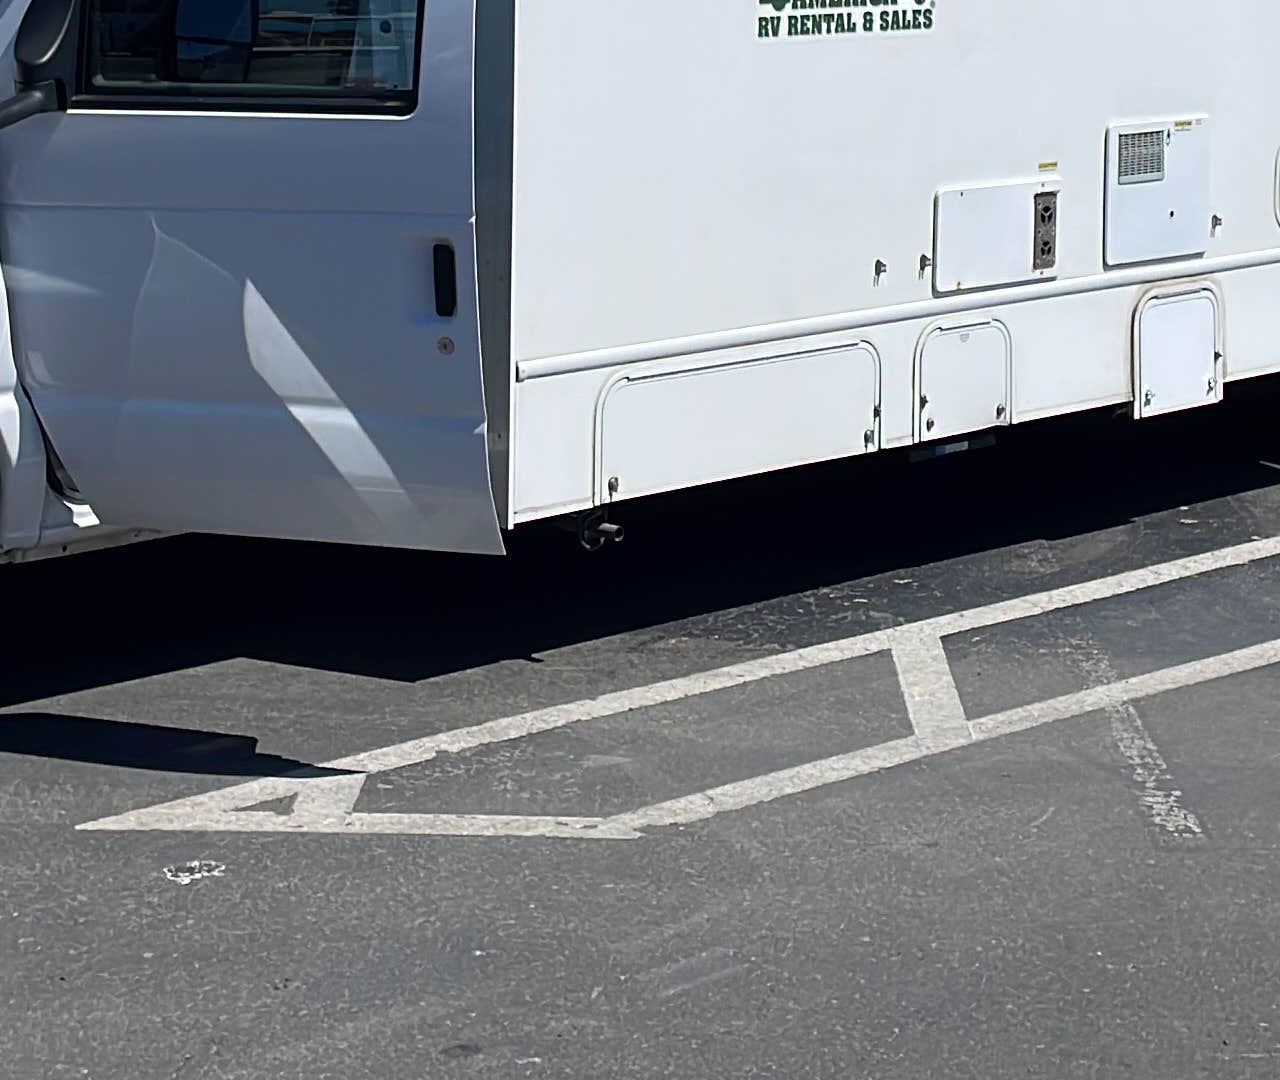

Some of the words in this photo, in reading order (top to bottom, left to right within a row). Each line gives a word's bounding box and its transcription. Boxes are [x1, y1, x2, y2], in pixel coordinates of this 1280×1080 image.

[757, 16, 782, 38] RV
[787, 12, 857, 36] RENTAL
[862, 11, 874, 32] &
[879, 8, 933, 32] SALES
